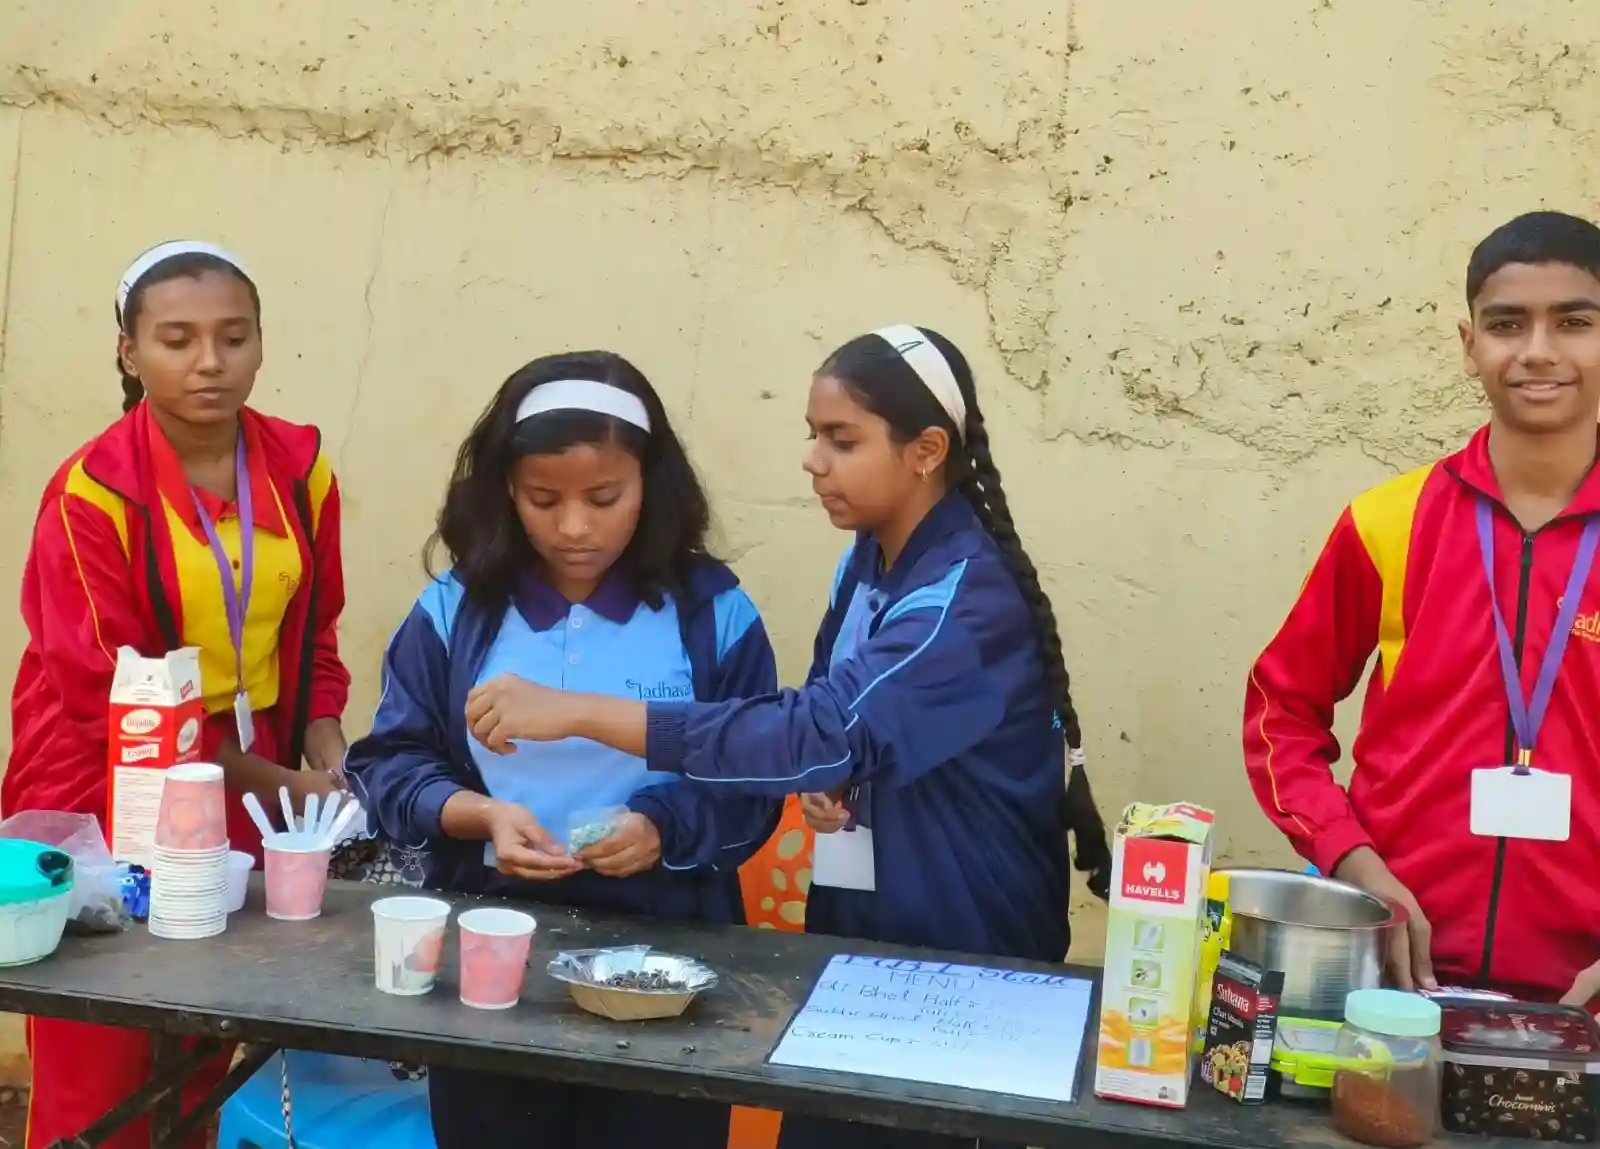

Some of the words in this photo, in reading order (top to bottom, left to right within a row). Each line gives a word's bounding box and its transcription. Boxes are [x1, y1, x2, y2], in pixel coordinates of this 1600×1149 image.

[1125, 883, 1181, 900] HAVELLS
[889, 970, 975, 990] MENU
[923, 992, 965, 1007] Half
[1216, 983, 1250, 1013] Suhana
